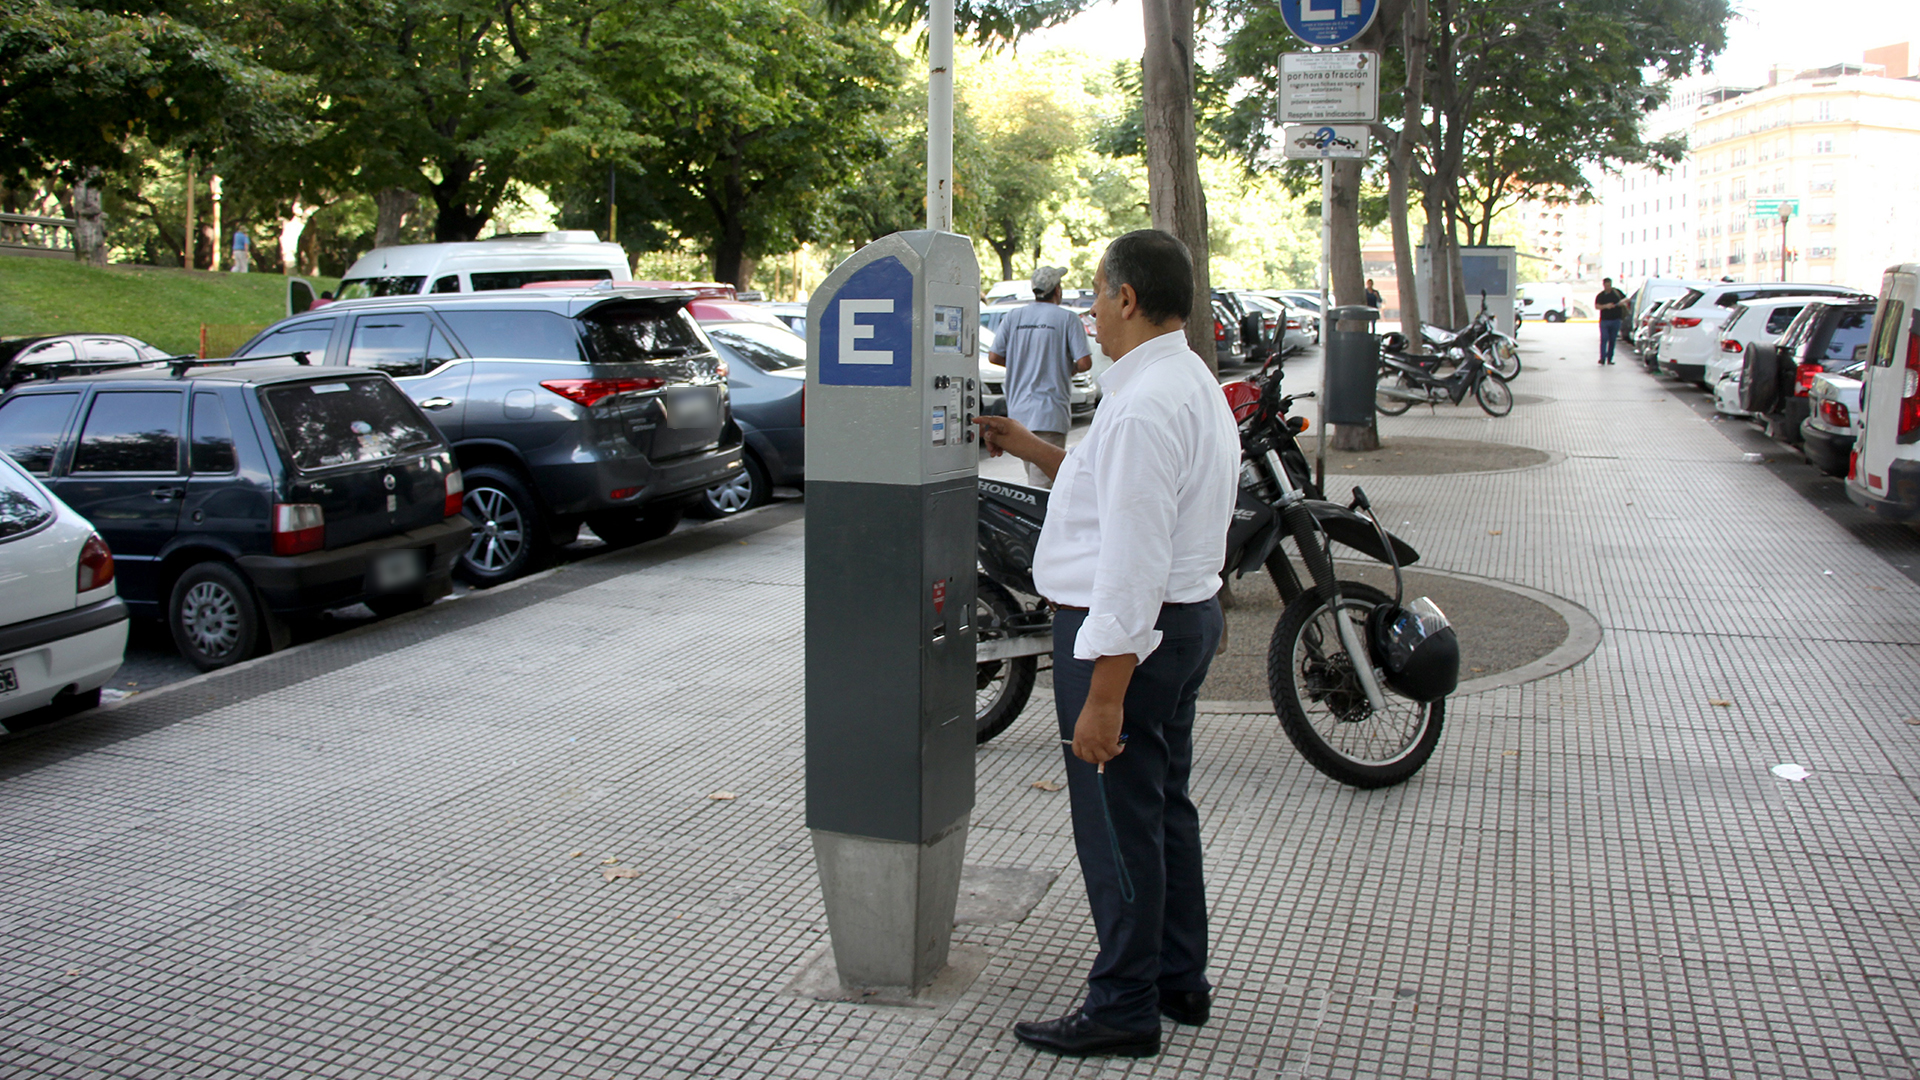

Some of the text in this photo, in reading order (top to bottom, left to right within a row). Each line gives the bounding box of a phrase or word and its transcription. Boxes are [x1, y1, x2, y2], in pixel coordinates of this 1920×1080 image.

[1287, 73, 1301, 82] por
[1303, 72, 1322, 80] hora
[1332, 70, 1368, 79] fracción
[1287, 111, 1313, 119] Respete
[1325, 110, 1366, 118] indicaciones
[838, 298, 895, 365] E
[978, 480, 1037, 506] HONDA
